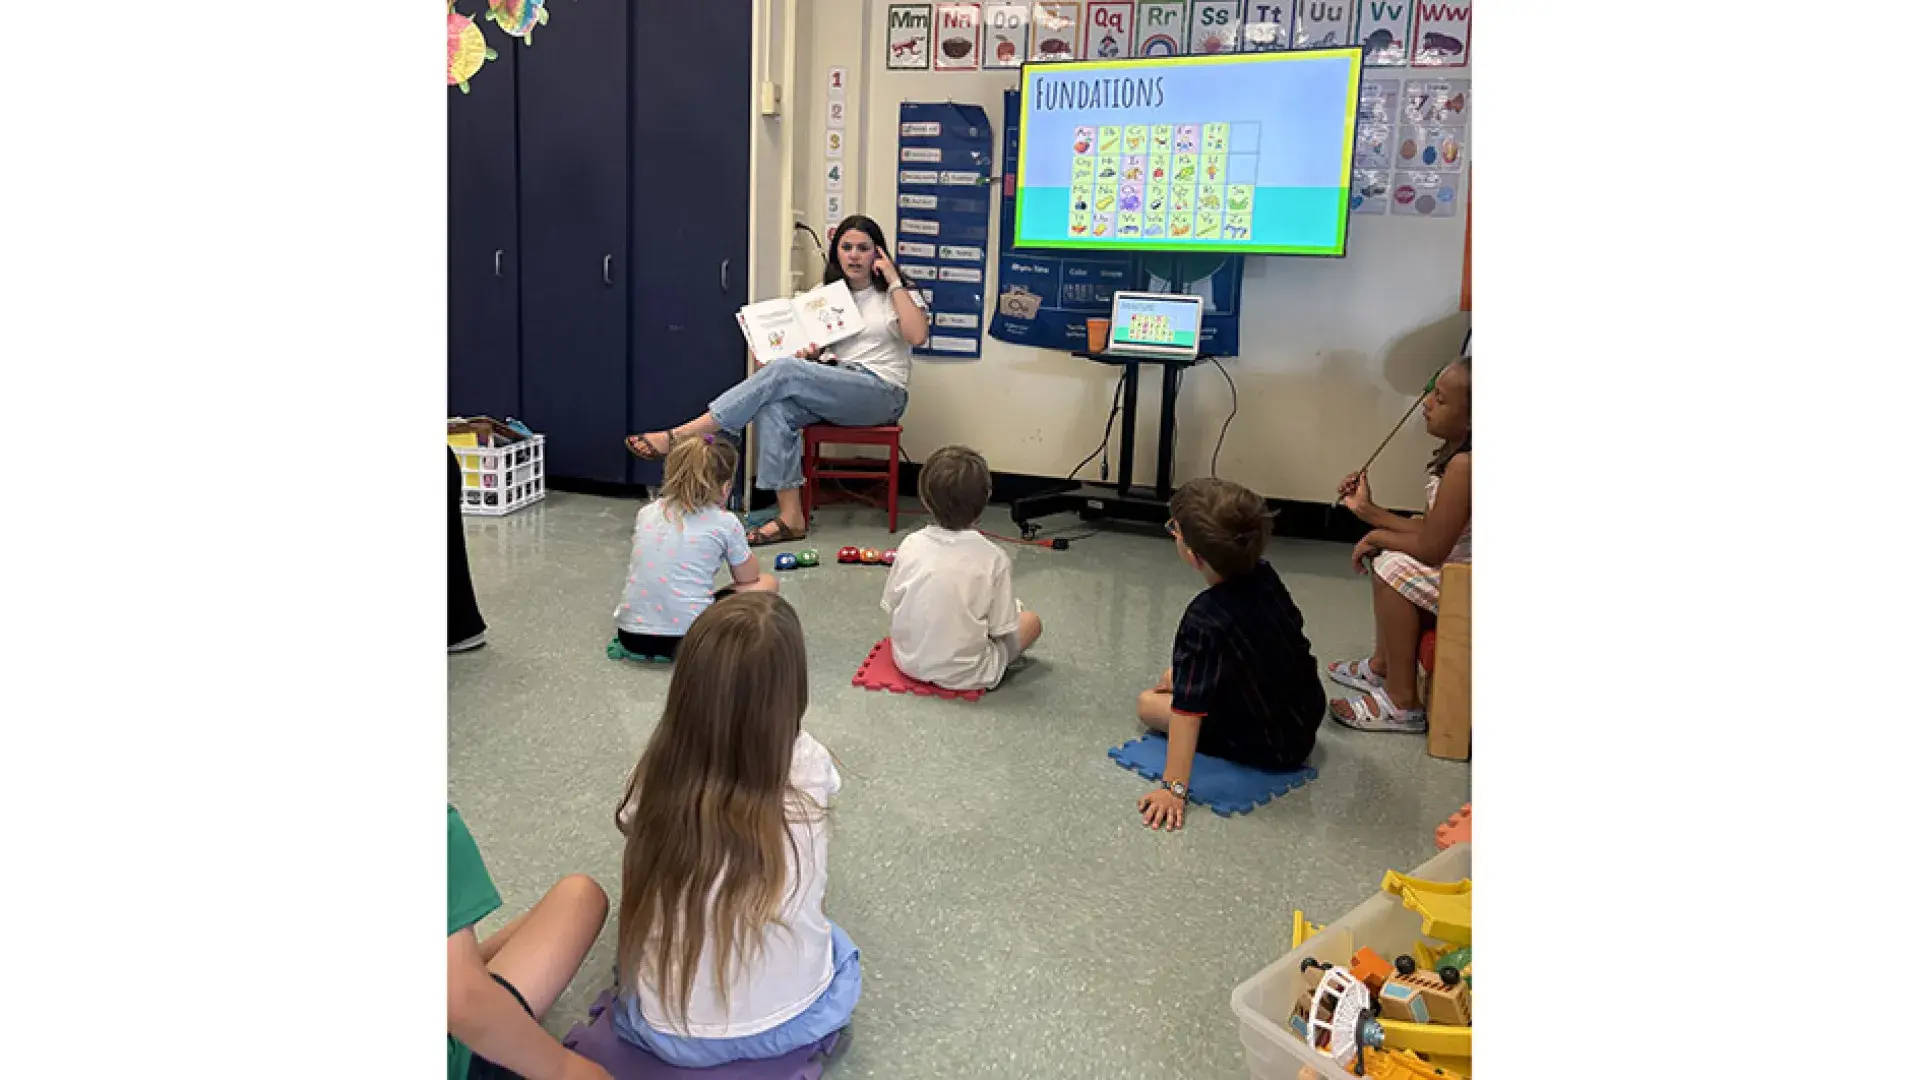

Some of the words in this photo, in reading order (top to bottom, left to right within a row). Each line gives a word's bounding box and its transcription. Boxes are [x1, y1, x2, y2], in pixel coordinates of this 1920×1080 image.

[891, 11, 926, 28] Mm
[1095, 7, 1124, 33] Qq
[1150, 7, 1177, 25] Rr
[1200, 7, 1229, 26] Ss
[1256, 5, 1282, 23] Tt
[1310, 2, 1342, 21] Uu
[1371, 2, 1403, 21] Vv
[1422, 3, 1468, 21] Ww
[832, 71, 842, 88] 1
[1036, 76, 1164, 111] FUNDATIONS
[831, 103, 842, 119] 2
[830, 133, 840, 150] 3
[828, 165, 840, 181] 4
[829, 197, 838, 212] 5
